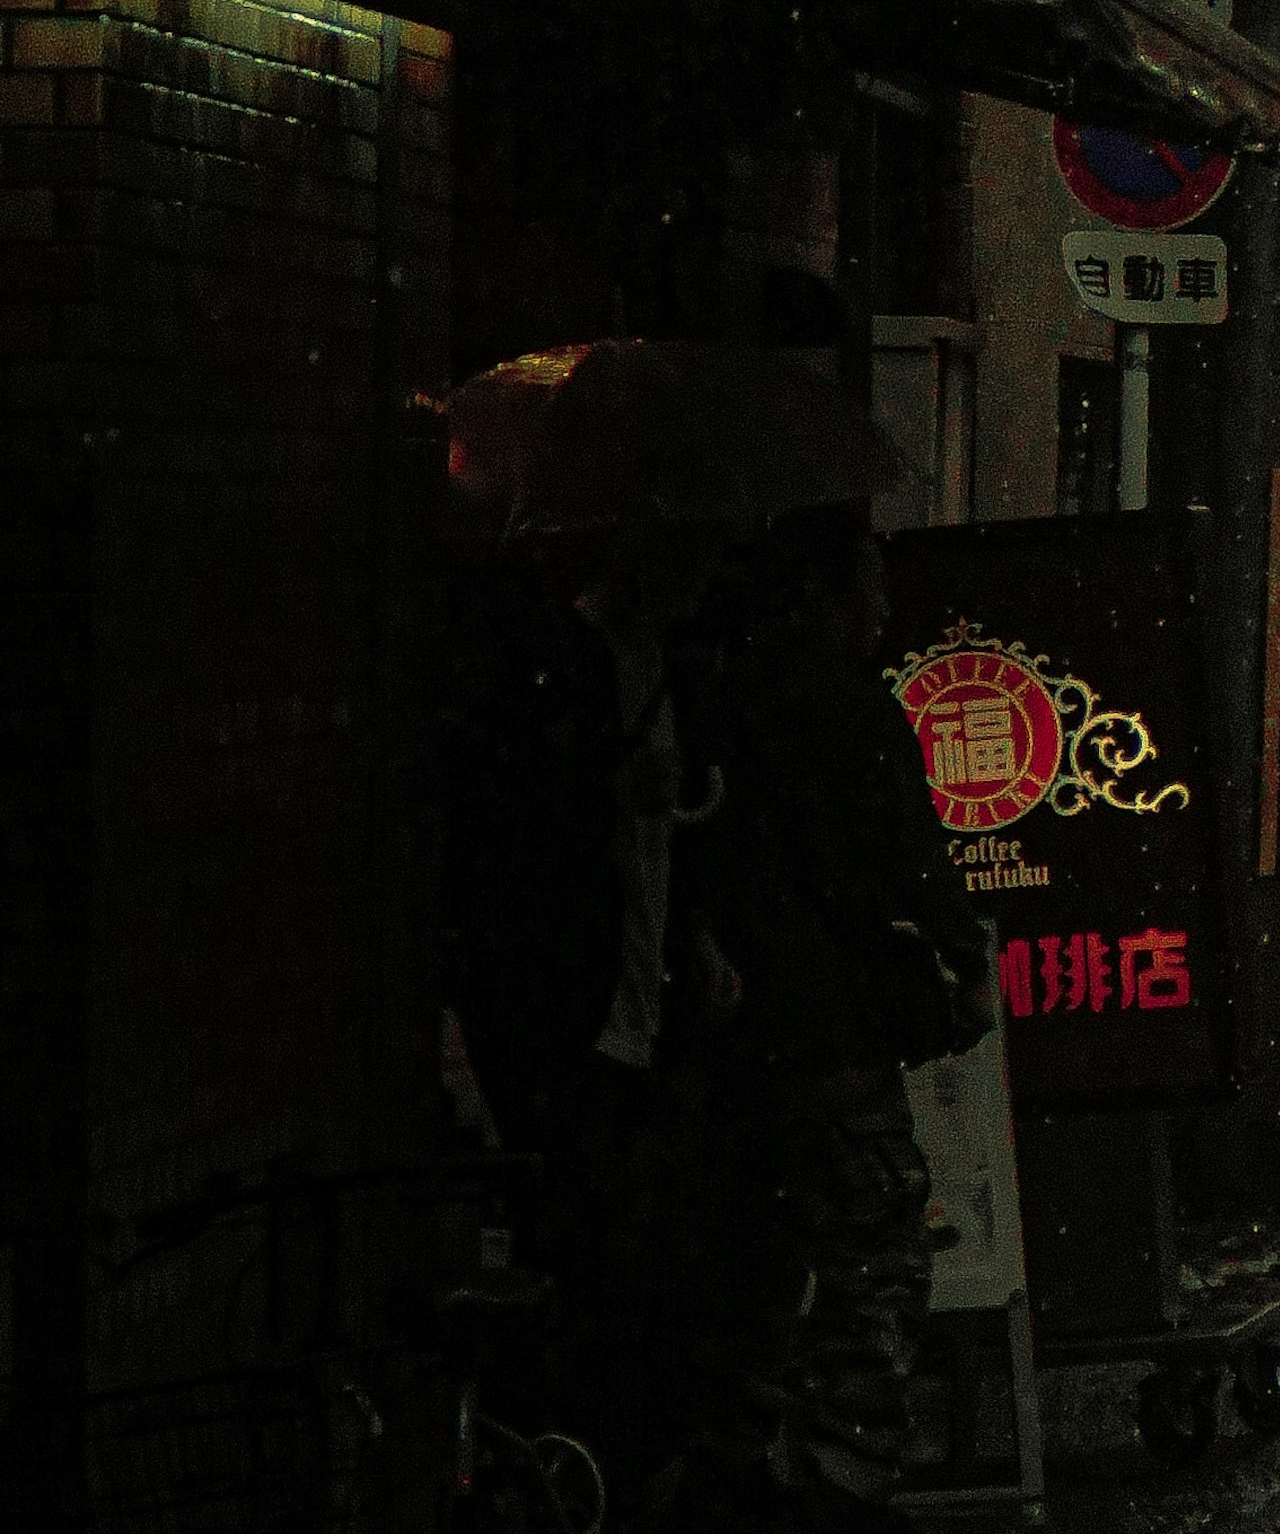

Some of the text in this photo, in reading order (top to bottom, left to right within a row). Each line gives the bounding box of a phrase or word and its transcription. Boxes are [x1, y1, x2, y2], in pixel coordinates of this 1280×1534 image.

[1076, 255, 1219, 302] 自動車
[929, 697, 1019, 787] 福
[963, 860, 1052, 893] rufuku
